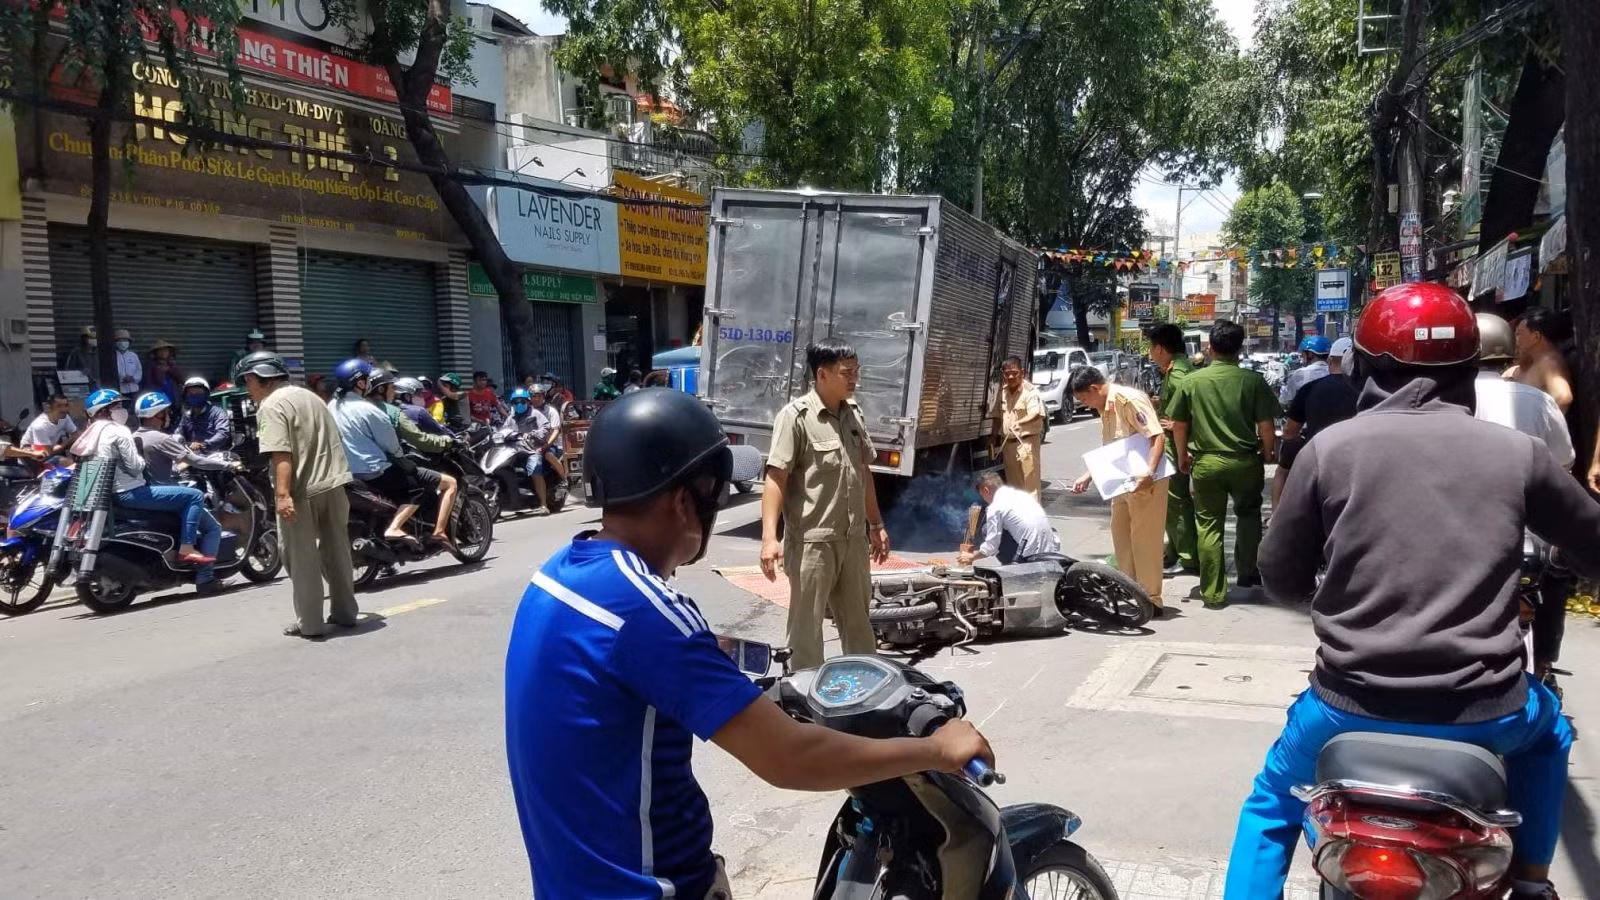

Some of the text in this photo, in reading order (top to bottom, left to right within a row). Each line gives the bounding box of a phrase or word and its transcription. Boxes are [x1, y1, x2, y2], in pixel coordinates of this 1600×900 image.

[283, 49, 348, 88] THIỆN
[223, 159, 236, 178] &
[257, 166, 290, 188] Gạch
[359, 179, 376, 202] Ốp
[394, 190, 415, 208] Cao
[517, 191, 602, 231] LAVENDER
[534, 223, 591, 245] NAILS SUPPLY
[531, 274, 561, 288] SUPPLY
[719, 326, 793, 344] 51D-130.66
